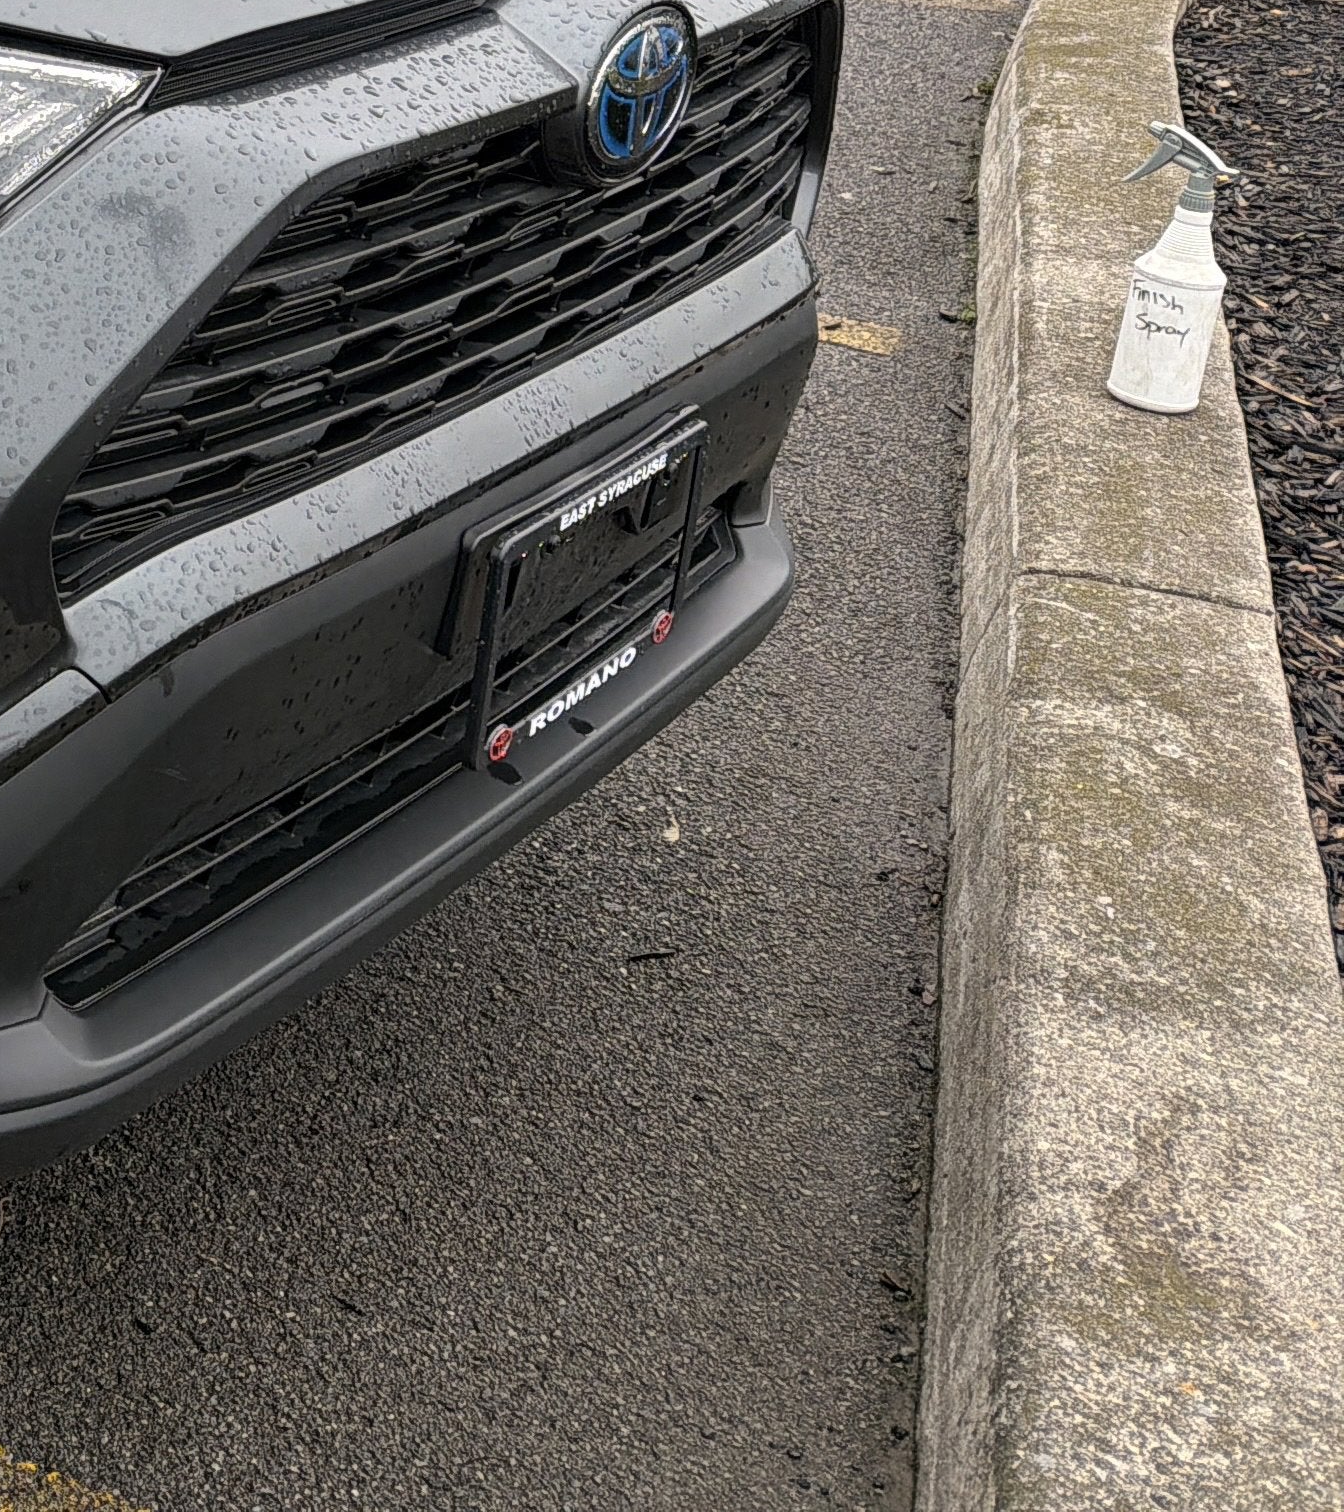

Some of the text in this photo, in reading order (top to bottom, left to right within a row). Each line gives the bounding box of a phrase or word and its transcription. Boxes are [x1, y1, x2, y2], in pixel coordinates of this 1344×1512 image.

[1135, 312, 1191, 348] Spray
[559, 451, 669, 531] EAST SYRACUSE
[529, 646, 637, 737] ROMANO
